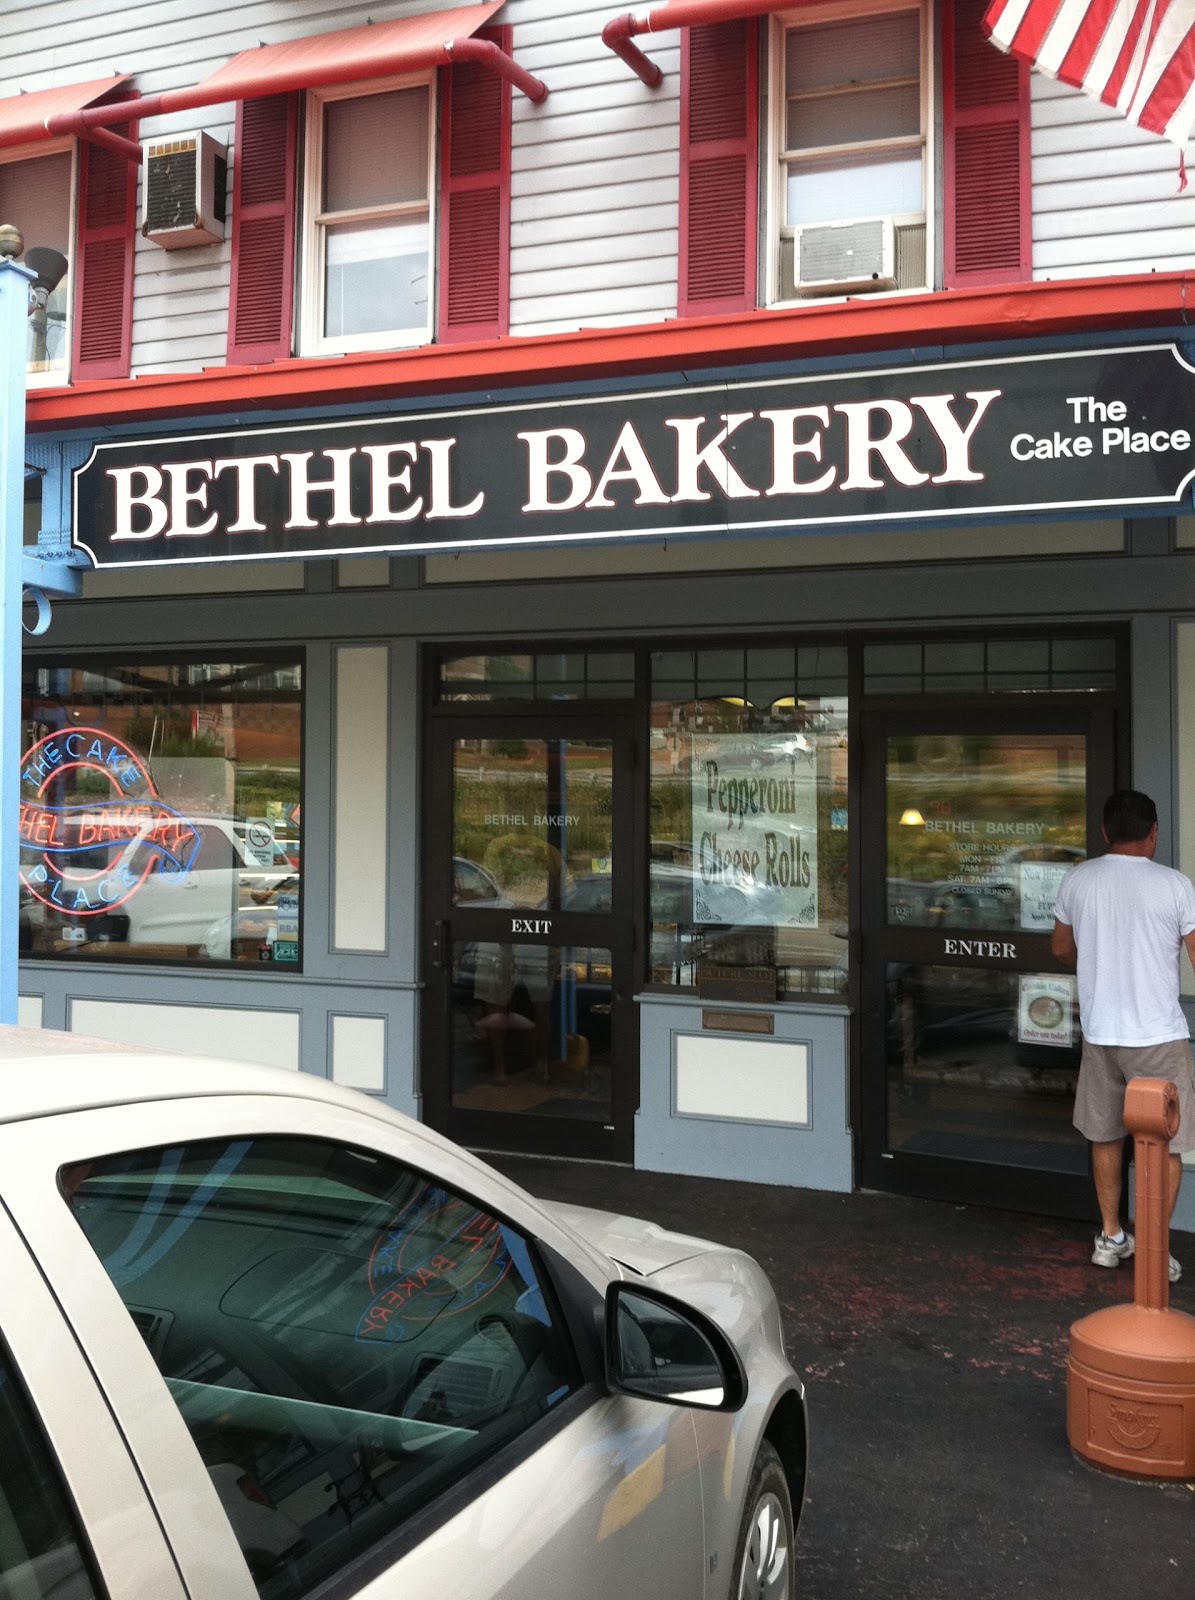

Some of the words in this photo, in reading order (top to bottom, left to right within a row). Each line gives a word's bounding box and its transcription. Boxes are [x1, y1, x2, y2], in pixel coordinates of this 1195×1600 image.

[1066, 396, 1128, 424] The
[1010, 431, 1093, 461] Cake
[1102, 426, 1191, 455] Place
[105, 437, 485, 543] BETHEL
[516, 388, 1002, 514] BAKERY
[22, 741, 63, 788] THE
[66, 733, 142, 788] CAKE
[706, 759, 797, 832] Pepperoni
[79, 805, 194, 852] BAKERY
[484, 814, 529, 826] BETHEL
[533, 814, 580, 827] BAKERY
[925, 820, 980, 833] BETHEL
[986, 822, 1045, 835] BAKERY
[949, 842, 980, 852] STORE
[960, 854, 982, 864] MON
[700, 831, 760, 887] Cheese
[764, 831, 811, 888] Rolls
[960, 864, 980, 873] 7AM
[29, 863, 140, 909] PLACE
[952, 886, 981, 895] CLOSED
[511, 918, 552, 934] EXIT
[943, 938, 1017, 959] ENTER
